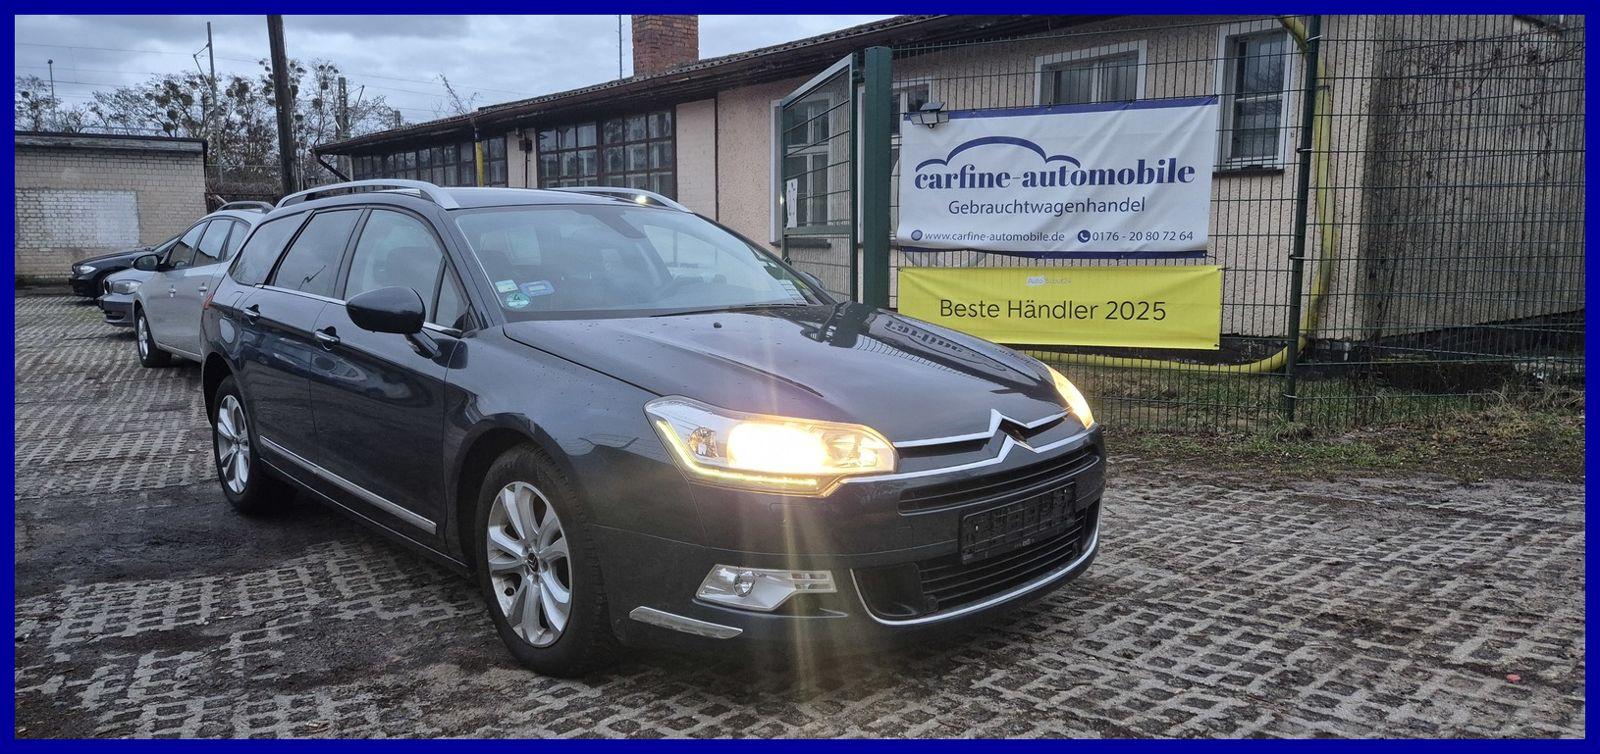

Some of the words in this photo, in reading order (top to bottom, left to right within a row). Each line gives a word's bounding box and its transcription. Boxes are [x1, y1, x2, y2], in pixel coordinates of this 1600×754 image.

[914, 158, 1195, 189] carfine-automobile
[948, 197, 1146, 217] Gebrauchtwagenhandel
[924, 230, 1065, 242] www.carfine-automobile.de
[1092, 231, 1119, 241] 0176
[1129, 231, 1143, 241] 20
[1145, 231, 1159, 241] 80
[1162, 231, 1176, 241] 72
[1179, 231, 1193, 241] 64
[940, 299, 1001, 318] Beste
[1007, 299, 1099, 320] Händler
[1105, 301, 1167, 321] 2025
